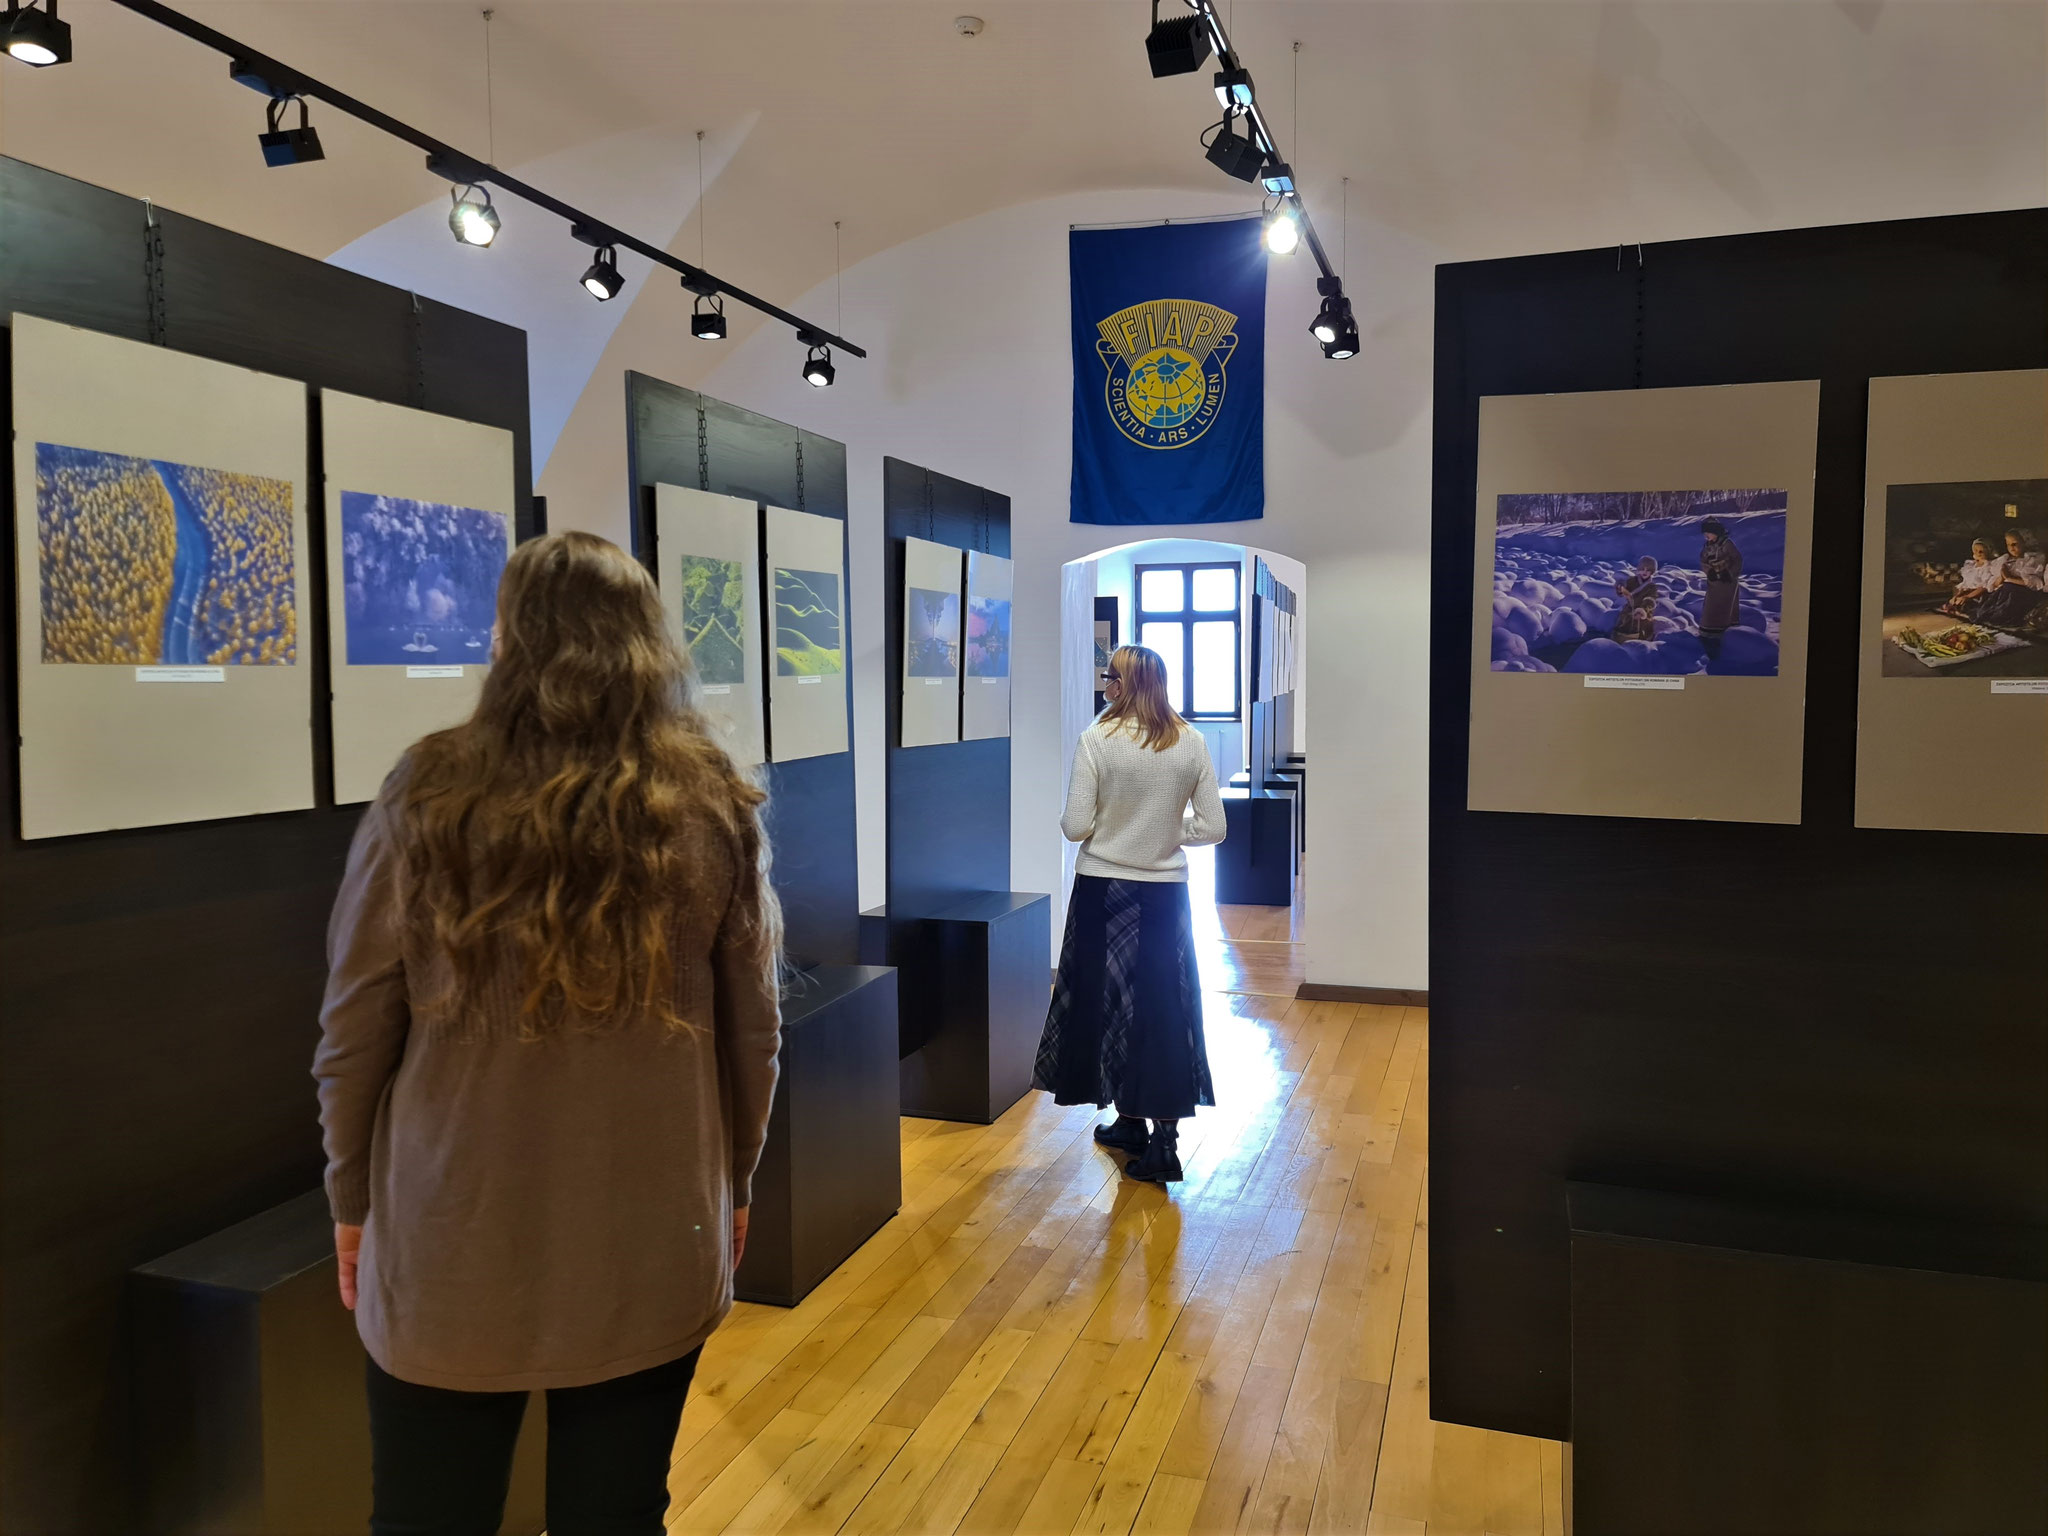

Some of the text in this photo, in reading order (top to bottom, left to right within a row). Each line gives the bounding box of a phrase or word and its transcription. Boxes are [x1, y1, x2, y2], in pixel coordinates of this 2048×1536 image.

[1120, 311, 1214, 354] FIAP
[1112, 373, 1220, 443] SCIENTIA ARS LUMEN
